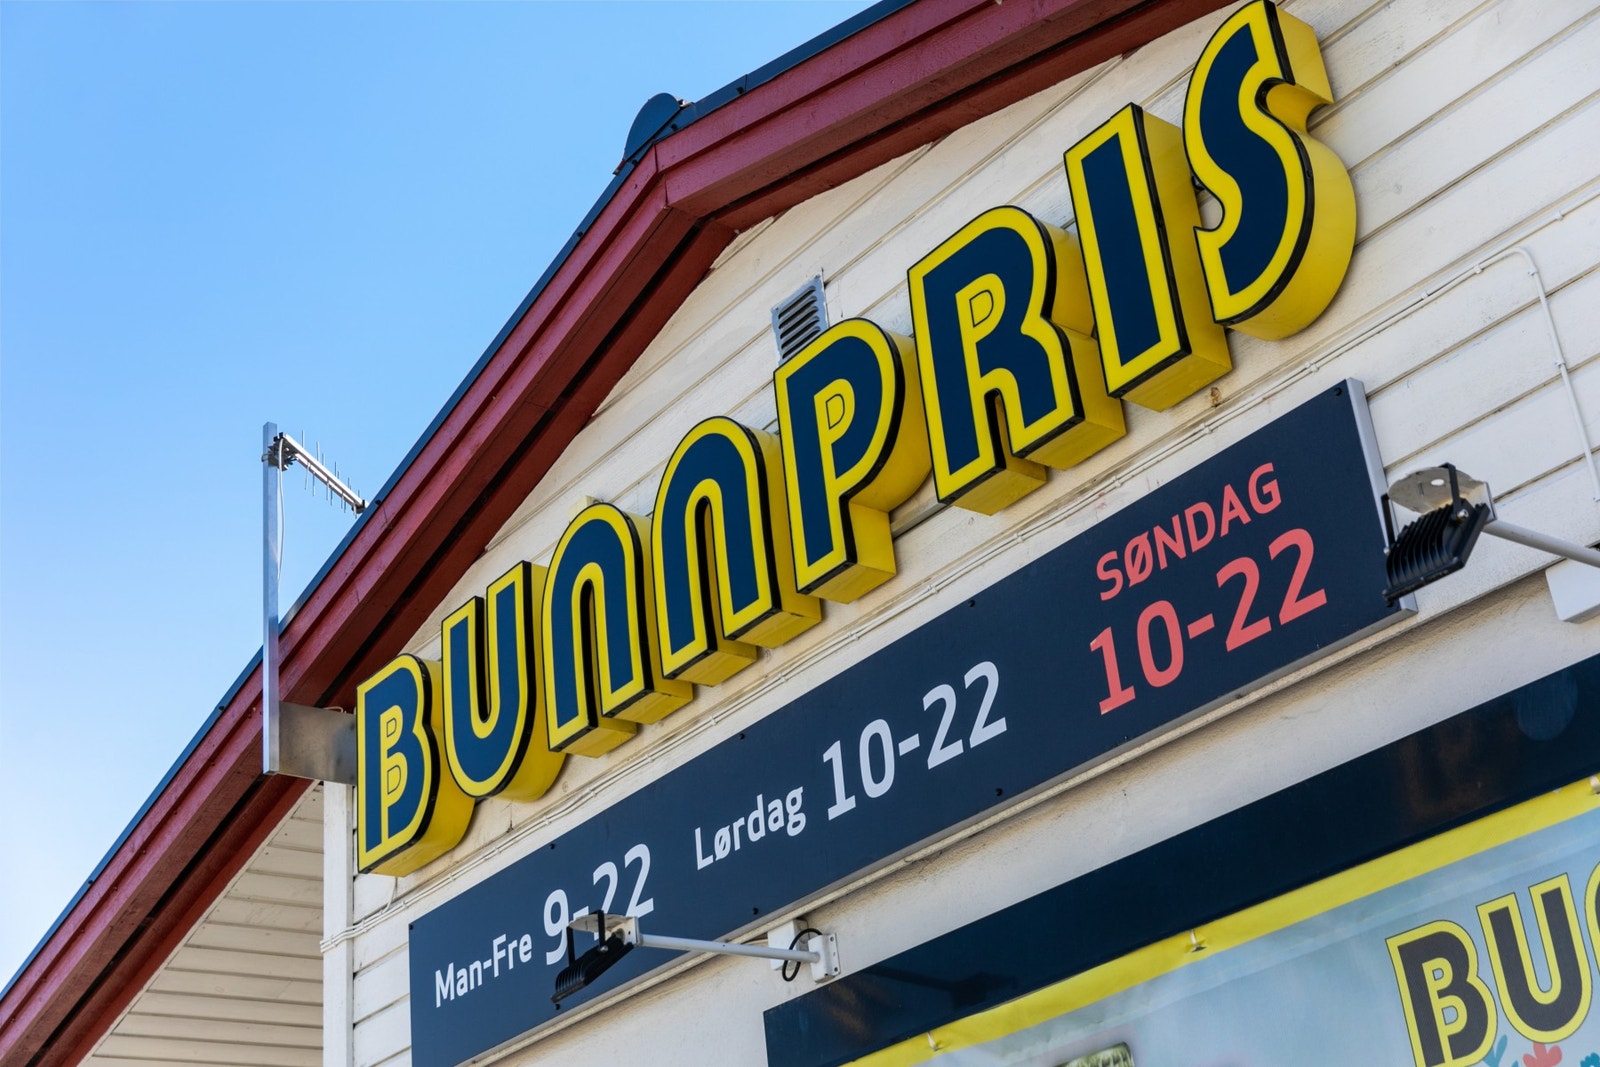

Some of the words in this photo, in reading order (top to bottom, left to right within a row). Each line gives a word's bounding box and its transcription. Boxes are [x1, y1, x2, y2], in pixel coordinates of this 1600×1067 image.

[1089, 527, 1327, 715] 10-22
[1095, 462, 1282, 601] SØNDAG
[694, 785, 807, 871] Lørdag
[822, 660, 1007, 821] 10-22
[434, 933, 533, 1009] Man-Fre
[1384, 860, 1600, 1067] BU
